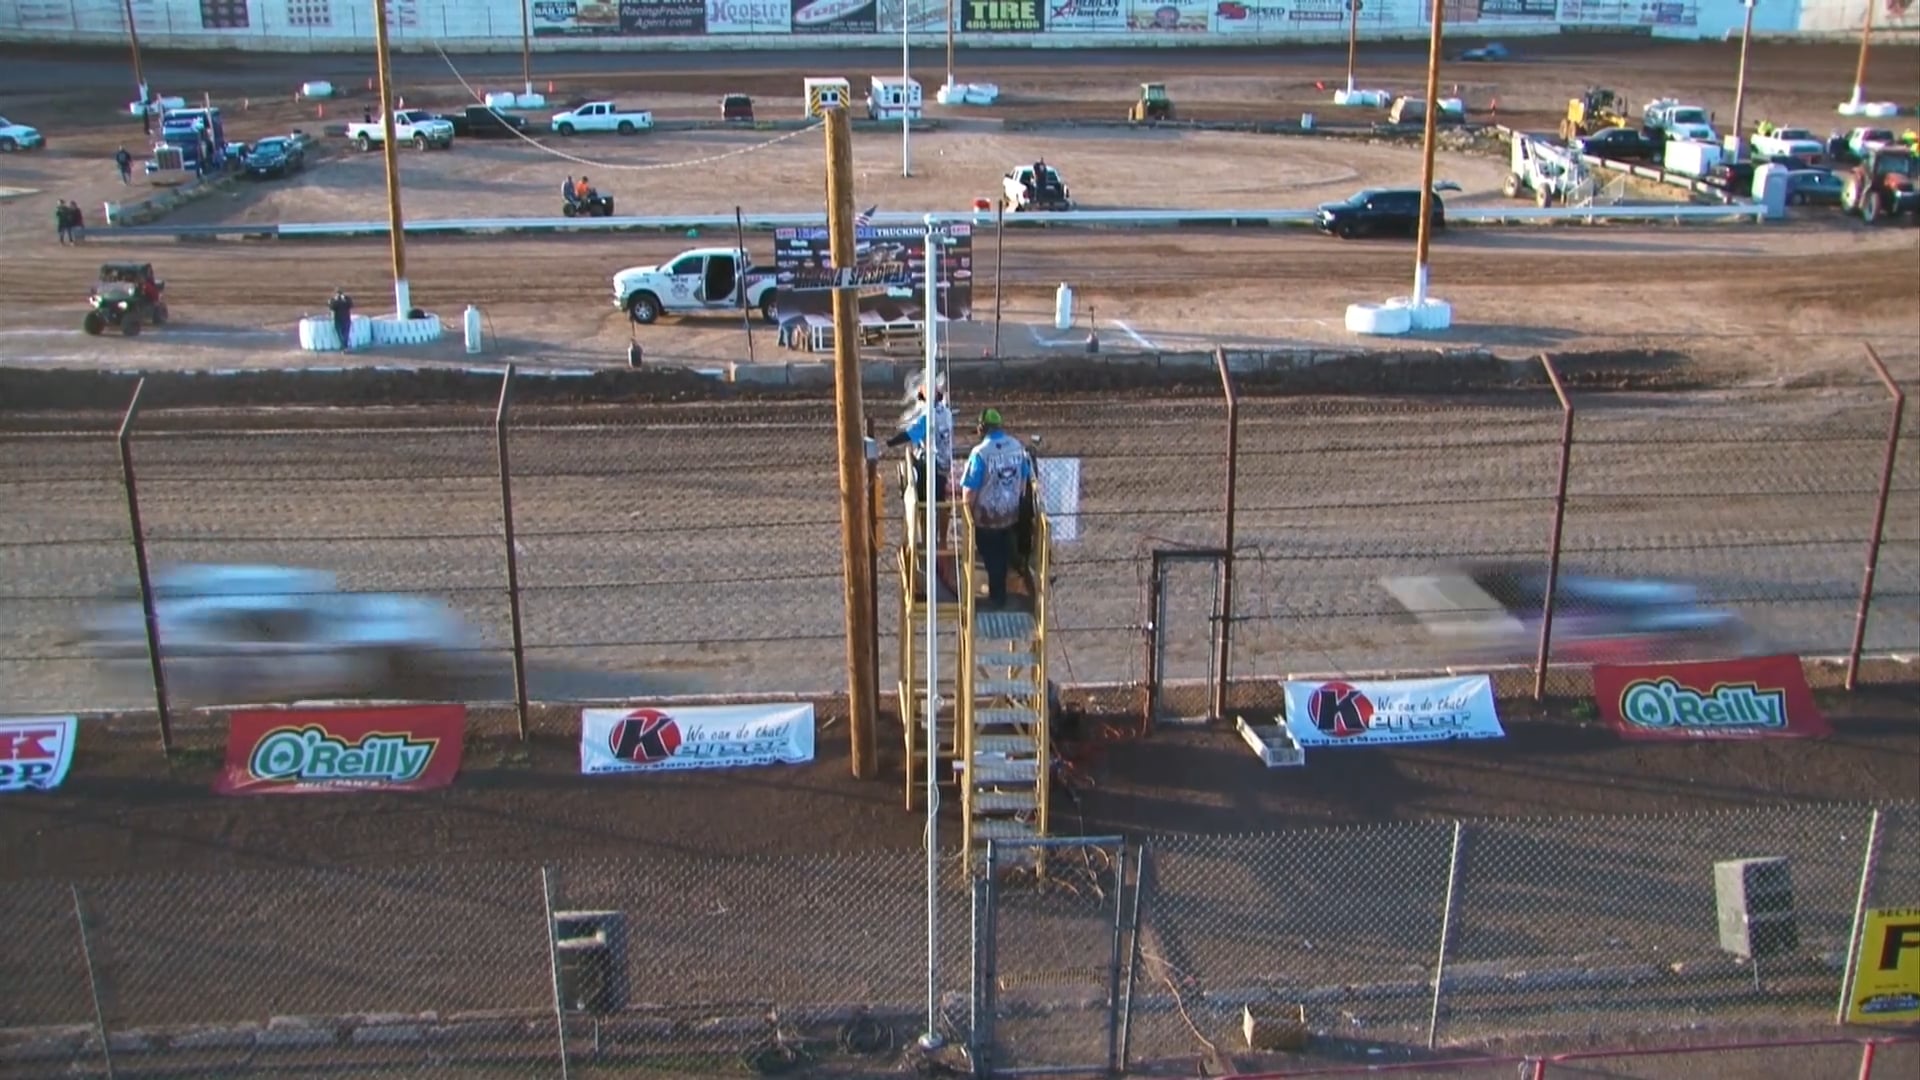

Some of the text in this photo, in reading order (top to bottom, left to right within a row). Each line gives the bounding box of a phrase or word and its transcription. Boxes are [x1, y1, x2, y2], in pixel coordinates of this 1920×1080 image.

[971, 2, 1034, 20] TIRE
[875, 227, 926, 239] TRUCKING
[1378, 696, 1395, 711] We
[1421, 697, 1434, 711] do
[1626, 682, 1783, 727] O'Reilly
[686, 725, 706, 742] We
[253, 729, 431, 781] O'Reilly
[1878, 908, 1920, 918] SECTI
